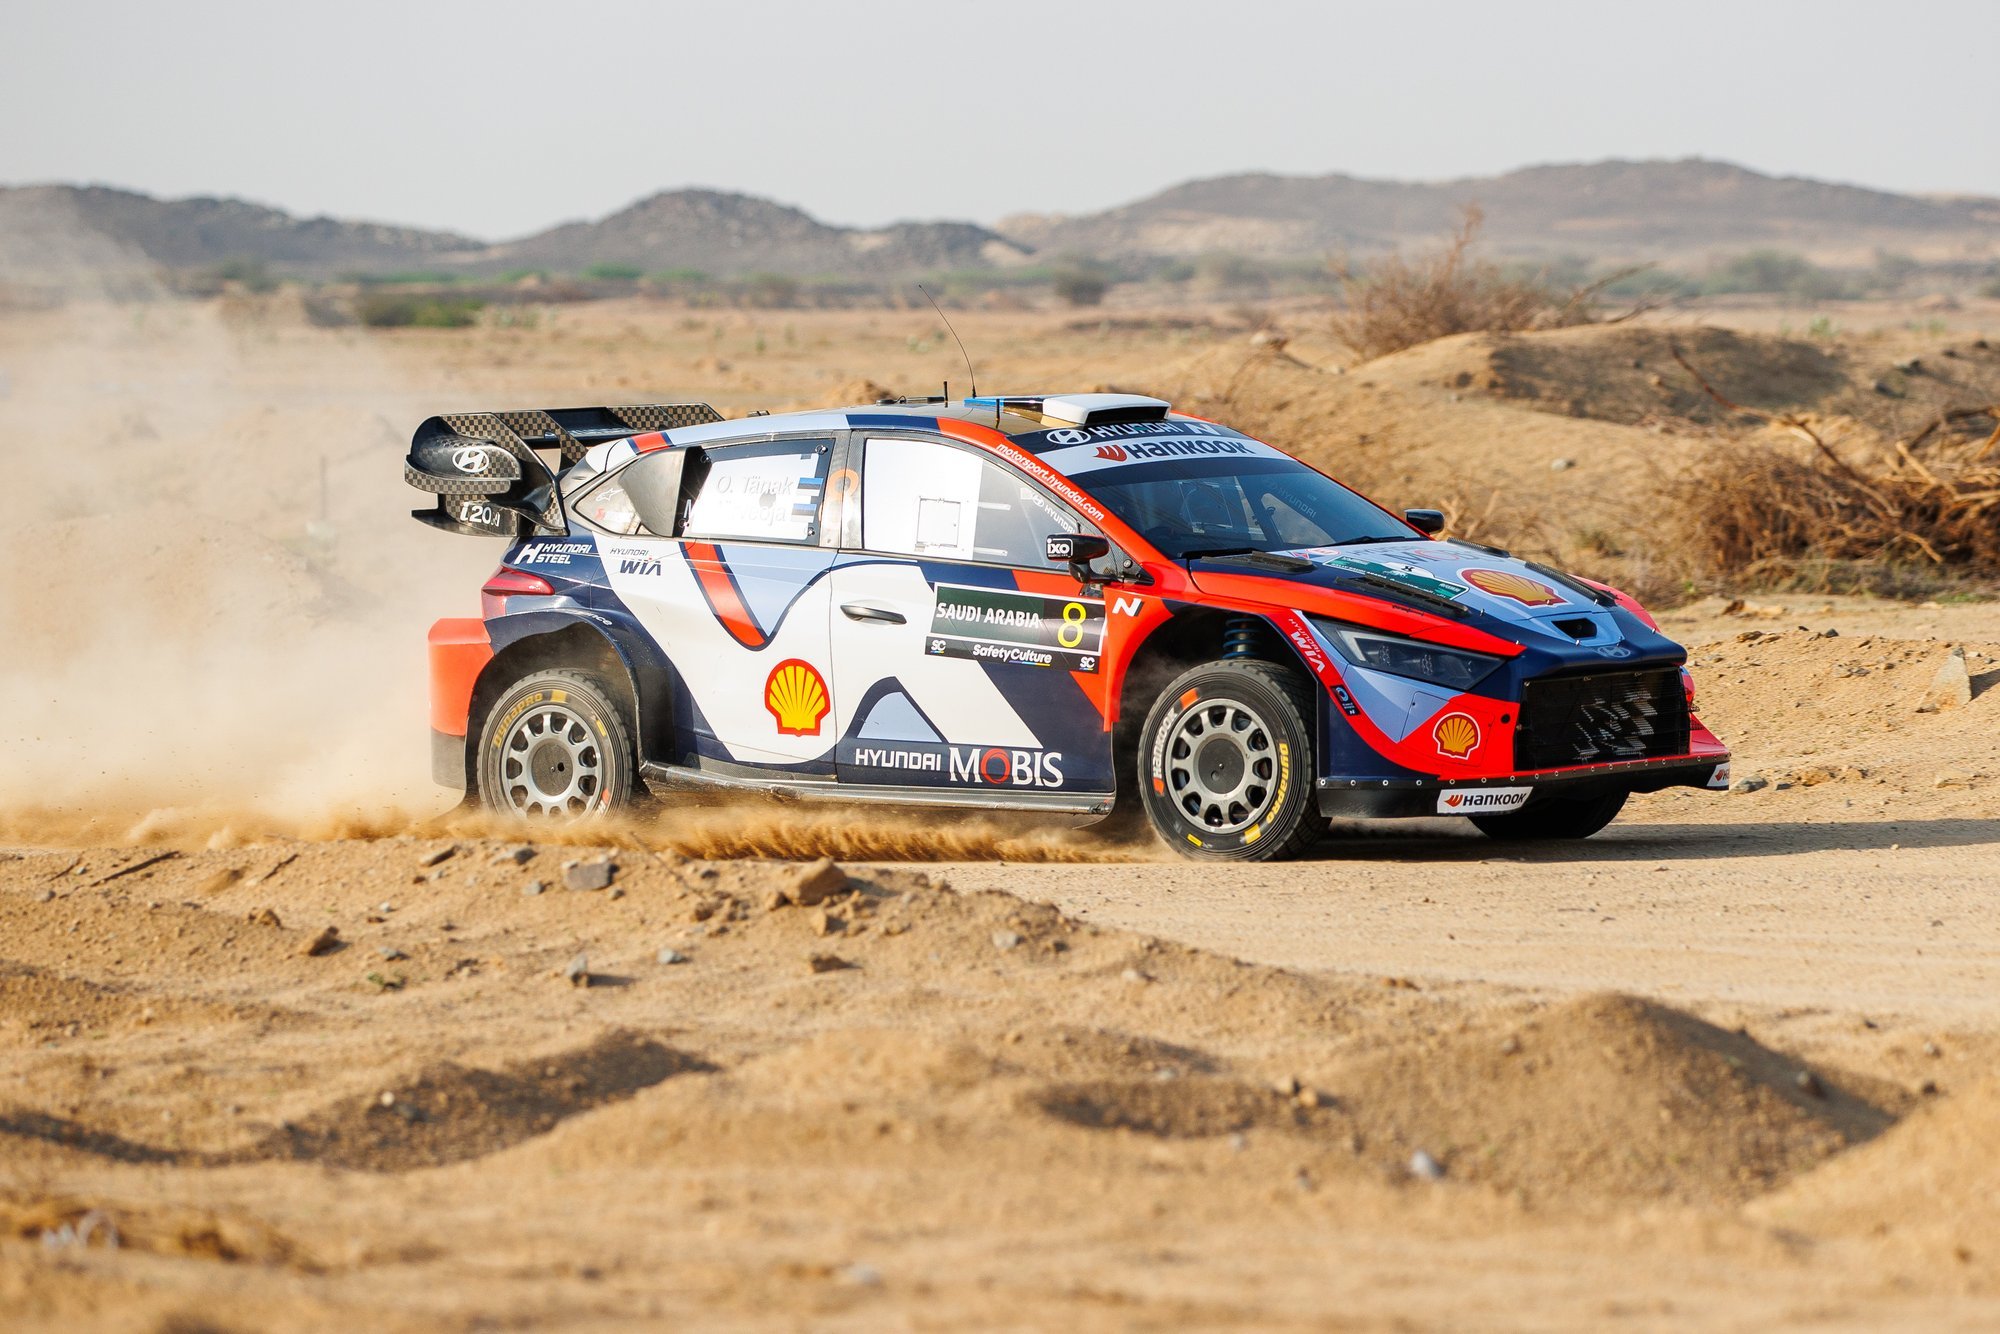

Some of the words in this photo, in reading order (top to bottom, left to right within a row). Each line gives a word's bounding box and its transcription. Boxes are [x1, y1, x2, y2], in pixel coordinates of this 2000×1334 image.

[1087, 422, 1184, 438] HYUNDAI
[995, 443, 1105, 521] motorsport.hyundai.com
[541, 543, 593, 554] HYUNDAI
[609, 547, 649, 556] HYUNDAI
[535, 553, 571, 565] STEEL
[936, 602, 981, 622] SAUDI
[983, 609, 1040, 629] ARABIA
[1112, 597, 1143, 617] N
[1057, 602, 1087, 648] 8
[930, 639, 946, 652] SC
[972, 643, 1053, 663] SafetyCulture
[1079, 656, 1095, 668] SC
[855, 748, 942, 771] HYUNDAI
[949, 747, 1064, 788] MOBIS
